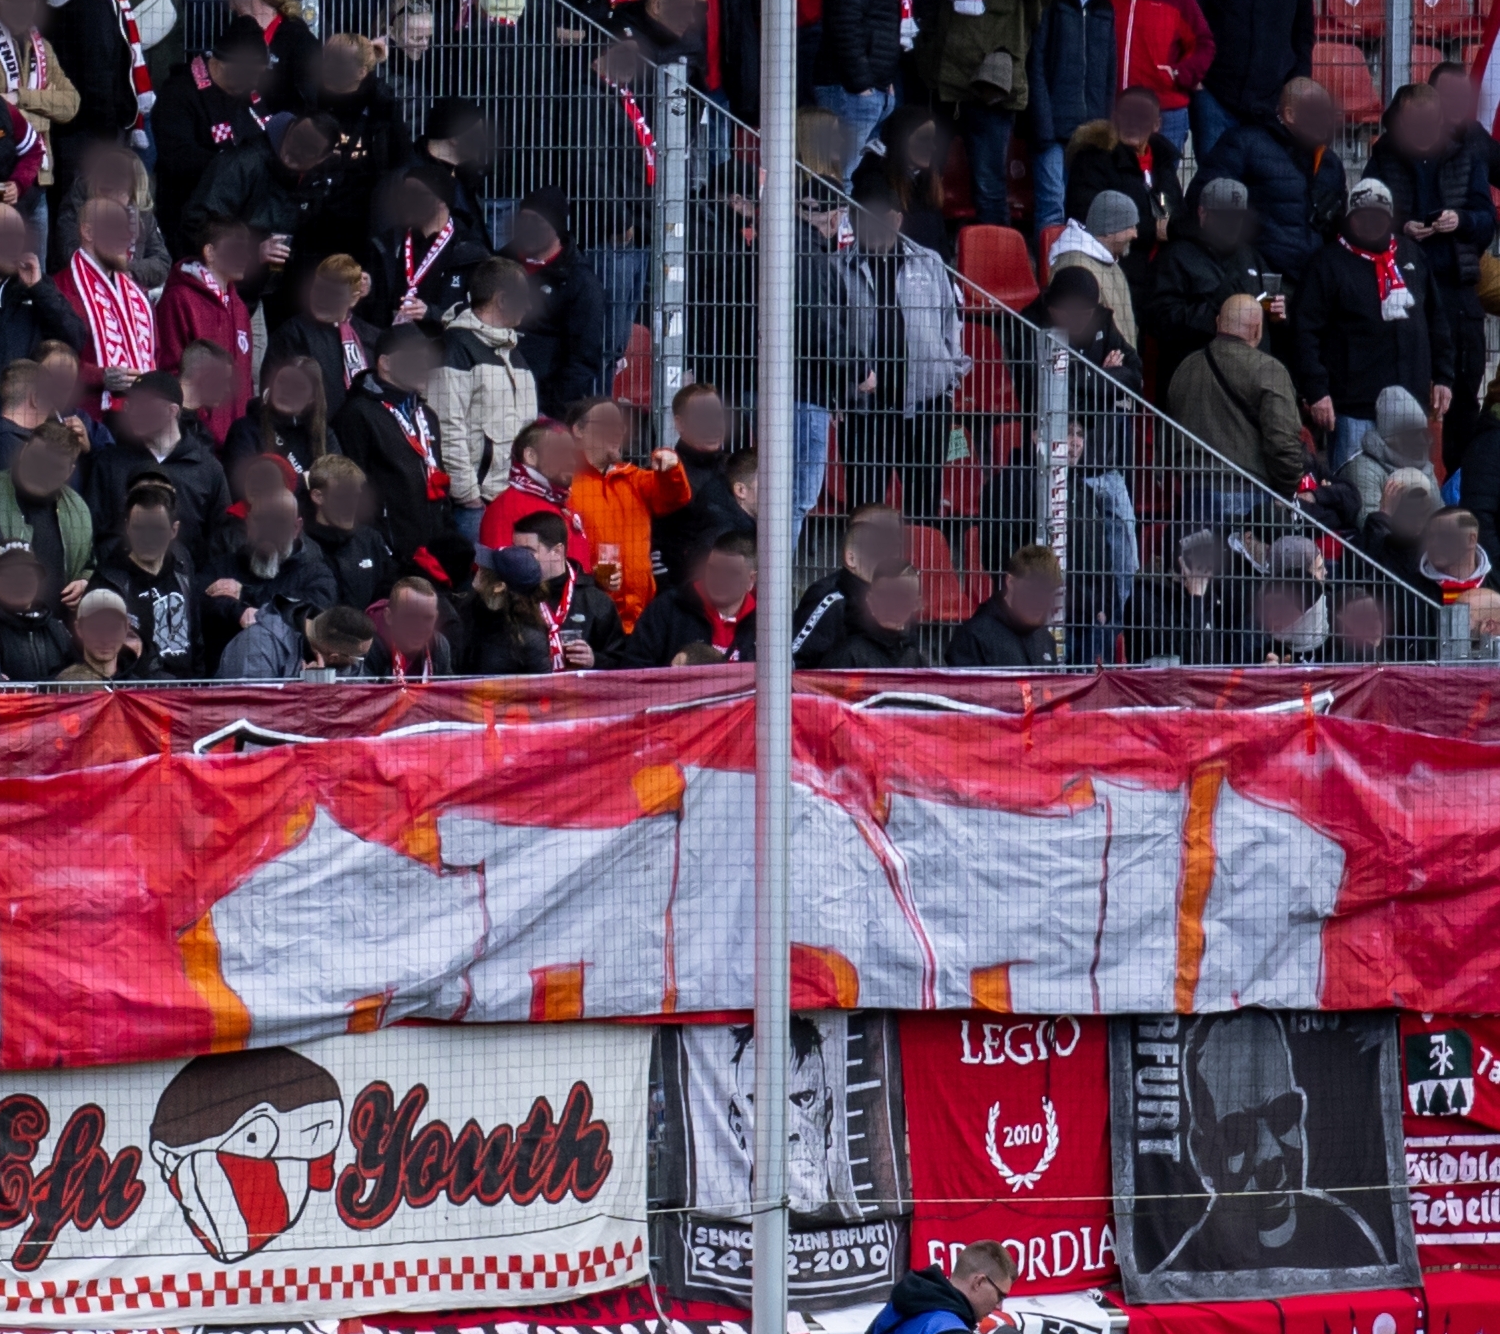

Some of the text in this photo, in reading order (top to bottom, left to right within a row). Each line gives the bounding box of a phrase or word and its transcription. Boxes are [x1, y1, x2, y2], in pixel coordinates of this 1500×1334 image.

[960, 1015, 1081, 1065] LEGIO
[338, 1080, 614, 1230] Youth
[1003, 1126, 1042, 1147] 2010
[832, 1225, 886, 1249] ERFURT
